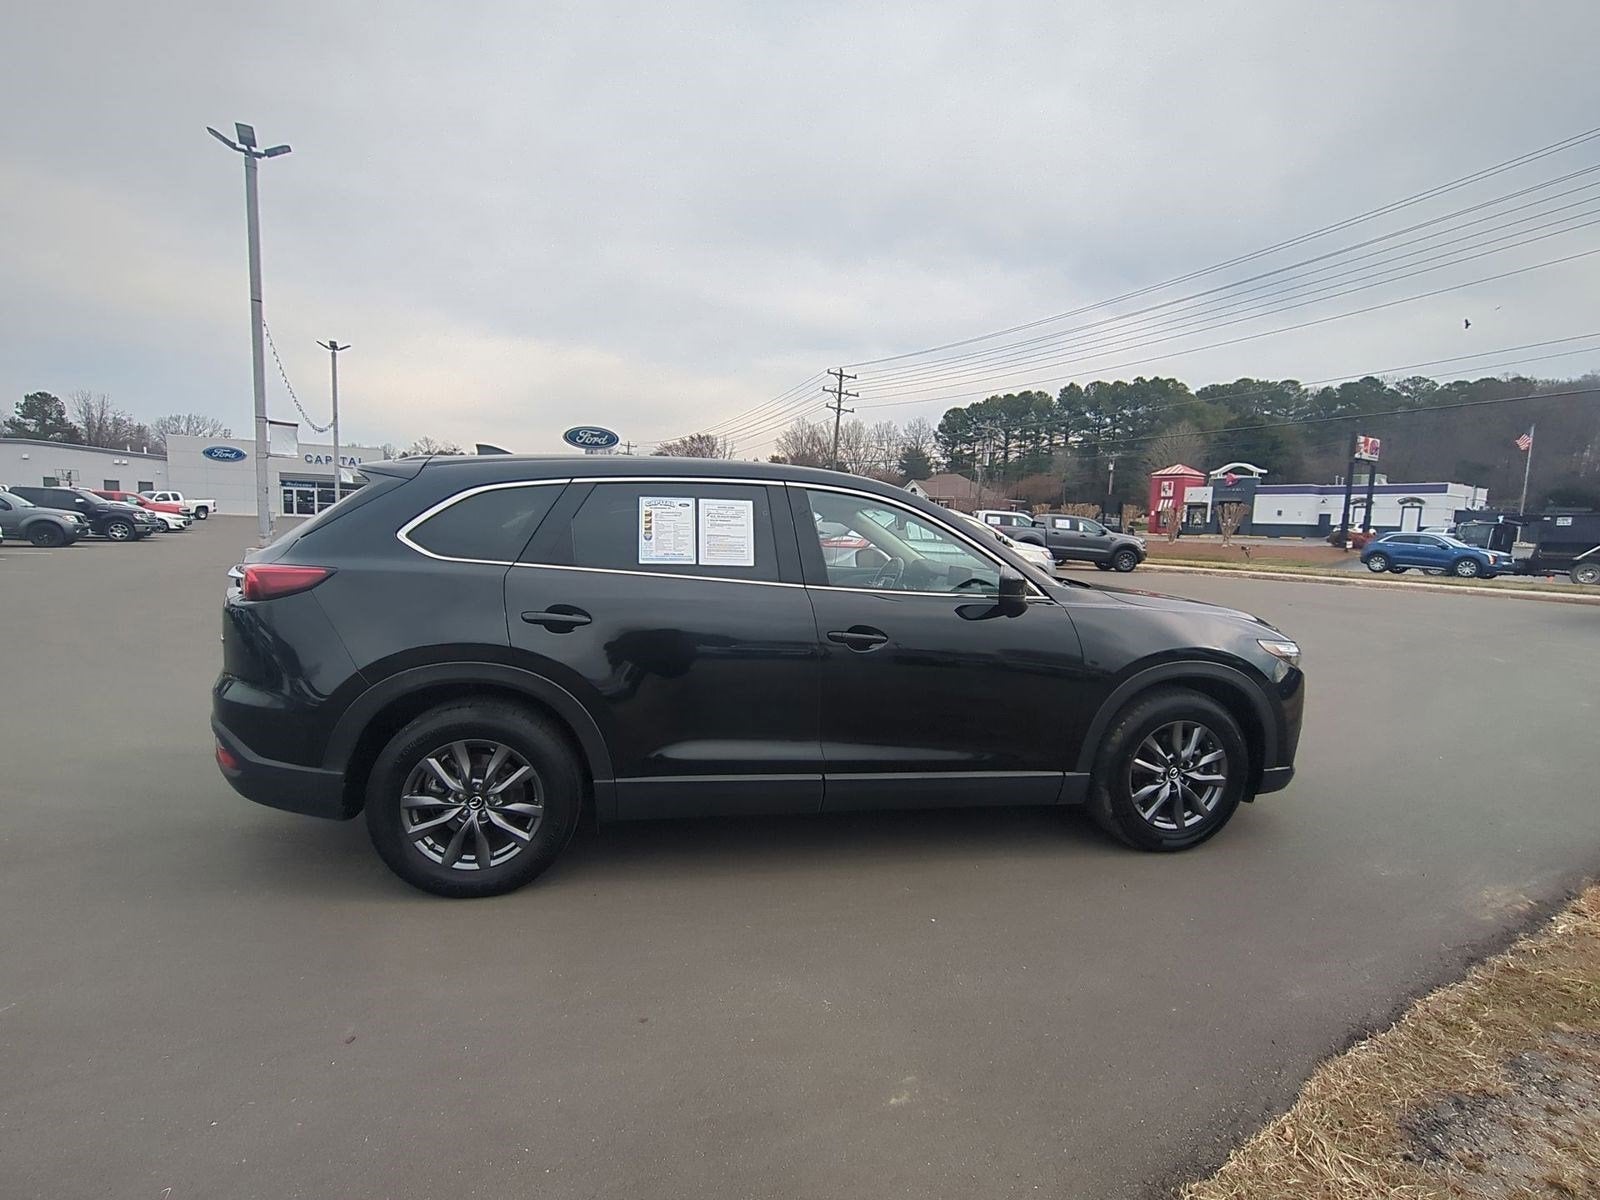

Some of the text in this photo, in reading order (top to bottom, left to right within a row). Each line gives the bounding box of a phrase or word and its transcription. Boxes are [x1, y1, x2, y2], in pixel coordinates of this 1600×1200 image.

[576, 429, 608, 445] Ford
[211, 448, 237, 458] Ford
[304, 454, 362, 466] CAPTA
